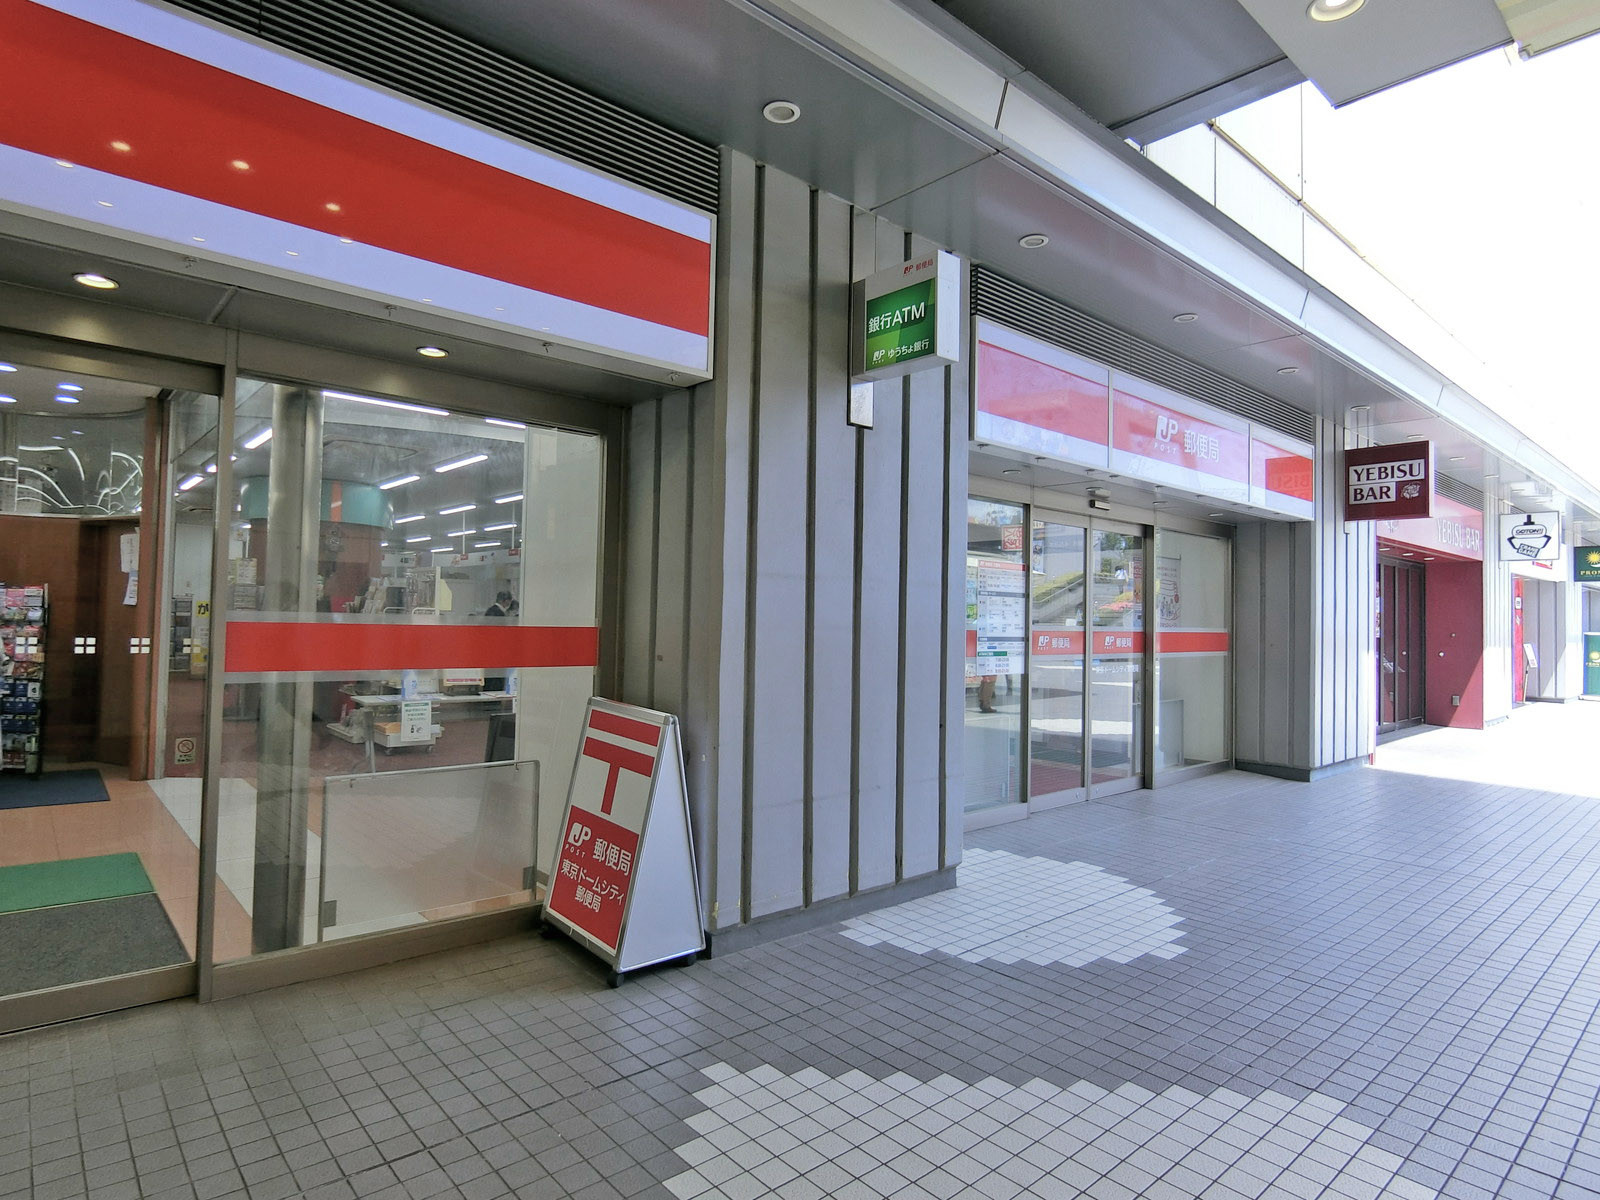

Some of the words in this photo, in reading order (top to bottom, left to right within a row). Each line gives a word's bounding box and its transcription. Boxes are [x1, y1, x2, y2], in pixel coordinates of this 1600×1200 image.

[916, 259, 933, 271] 郵便局
[868, 302, 925, 333] 銀行ATM
[873, 350, 885, 361] JP
[888, 339, 929, 358] ゆうちょ銀行
[1153, 442, 1177, 455] POST
[1155, 415, 1179, 442] JP
[1183, 429, 1220, 463] 郵便局
[1353, 463, 1421, 482] YEBISU
[1353, 485, 1391, 501] BAR
[1437, 519, 1463, 548] YEBISU
[1466, 528, 1480, 552] BAR
[564, 843, 586, 858] POST
[567, 822, 592, 847] JP
[592, 838, 632, 876] 郵便局
[560, 858, 625, 905] 東京ドームシティ
[574, 885, 602, 912] 郵便局
